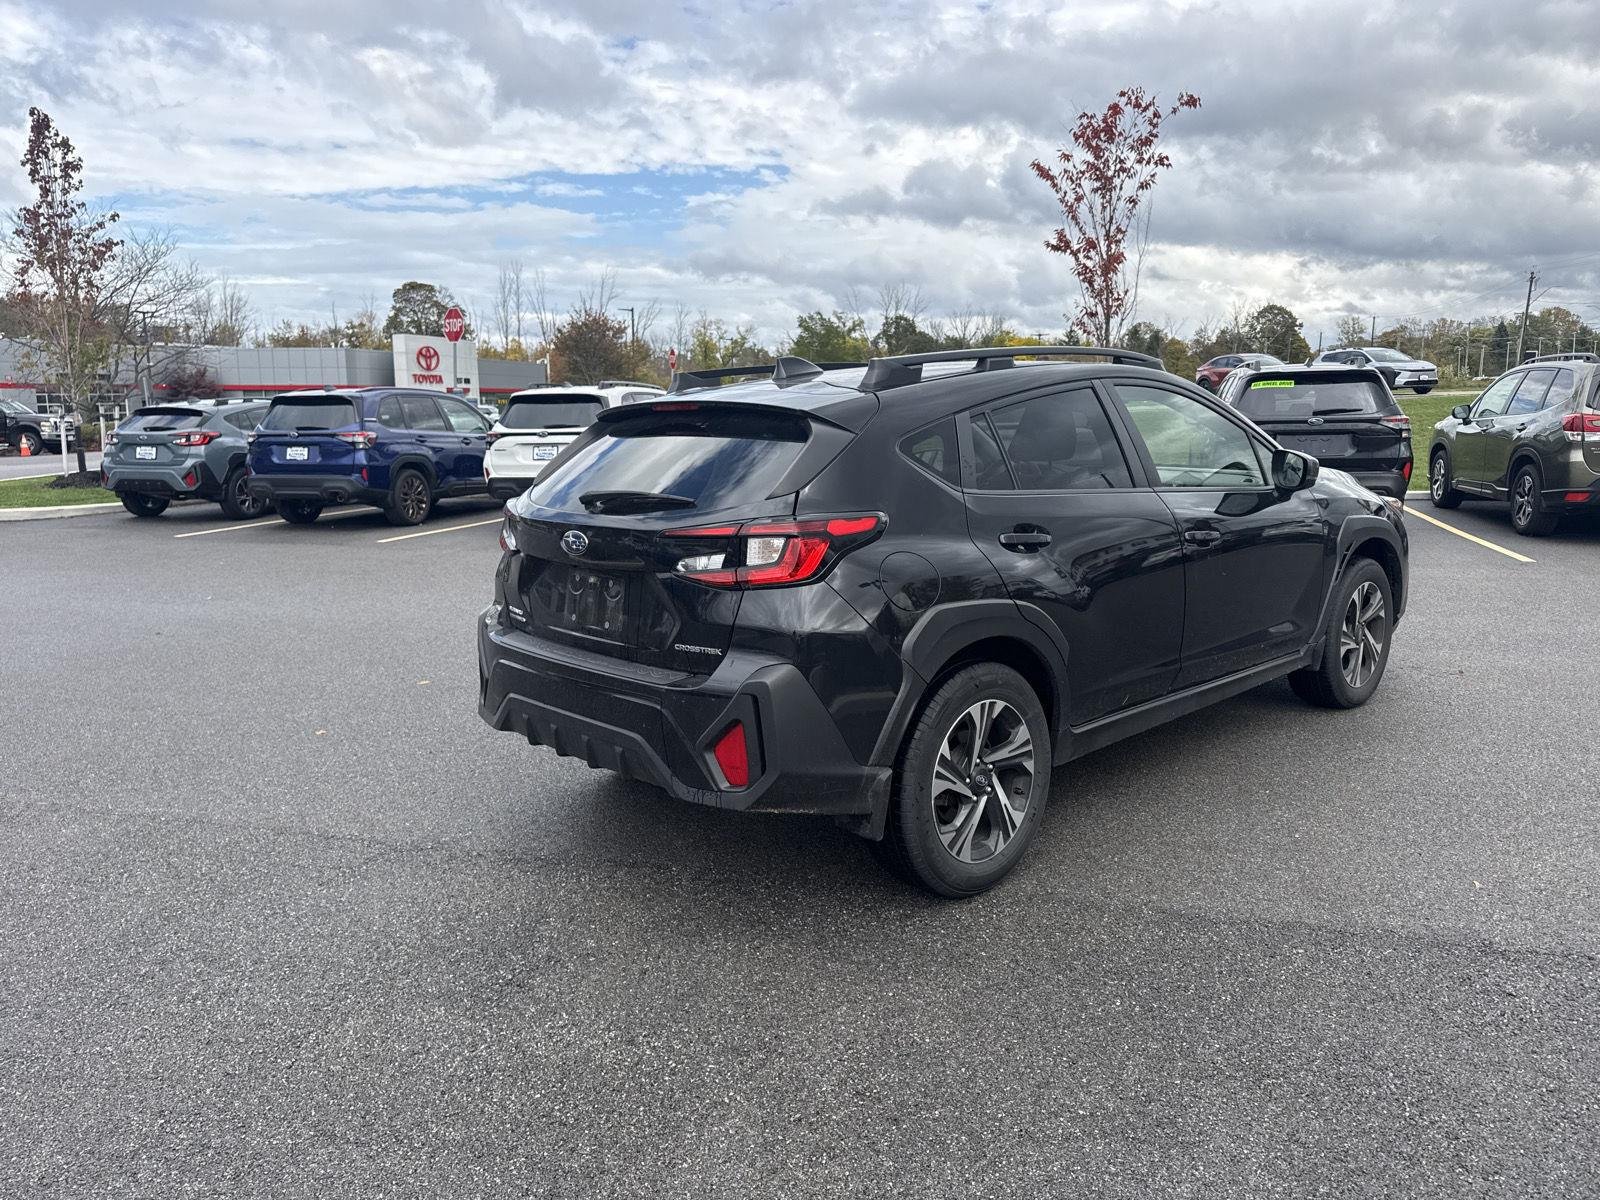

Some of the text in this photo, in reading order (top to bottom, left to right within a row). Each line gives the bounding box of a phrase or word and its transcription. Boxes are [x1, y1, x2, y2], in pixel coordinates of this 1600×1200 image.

[445, 318, 462, 332] STOP
[412, 374, 444, 384] TOYOTA
[674, 643, 723, 656] CROSSTREK
